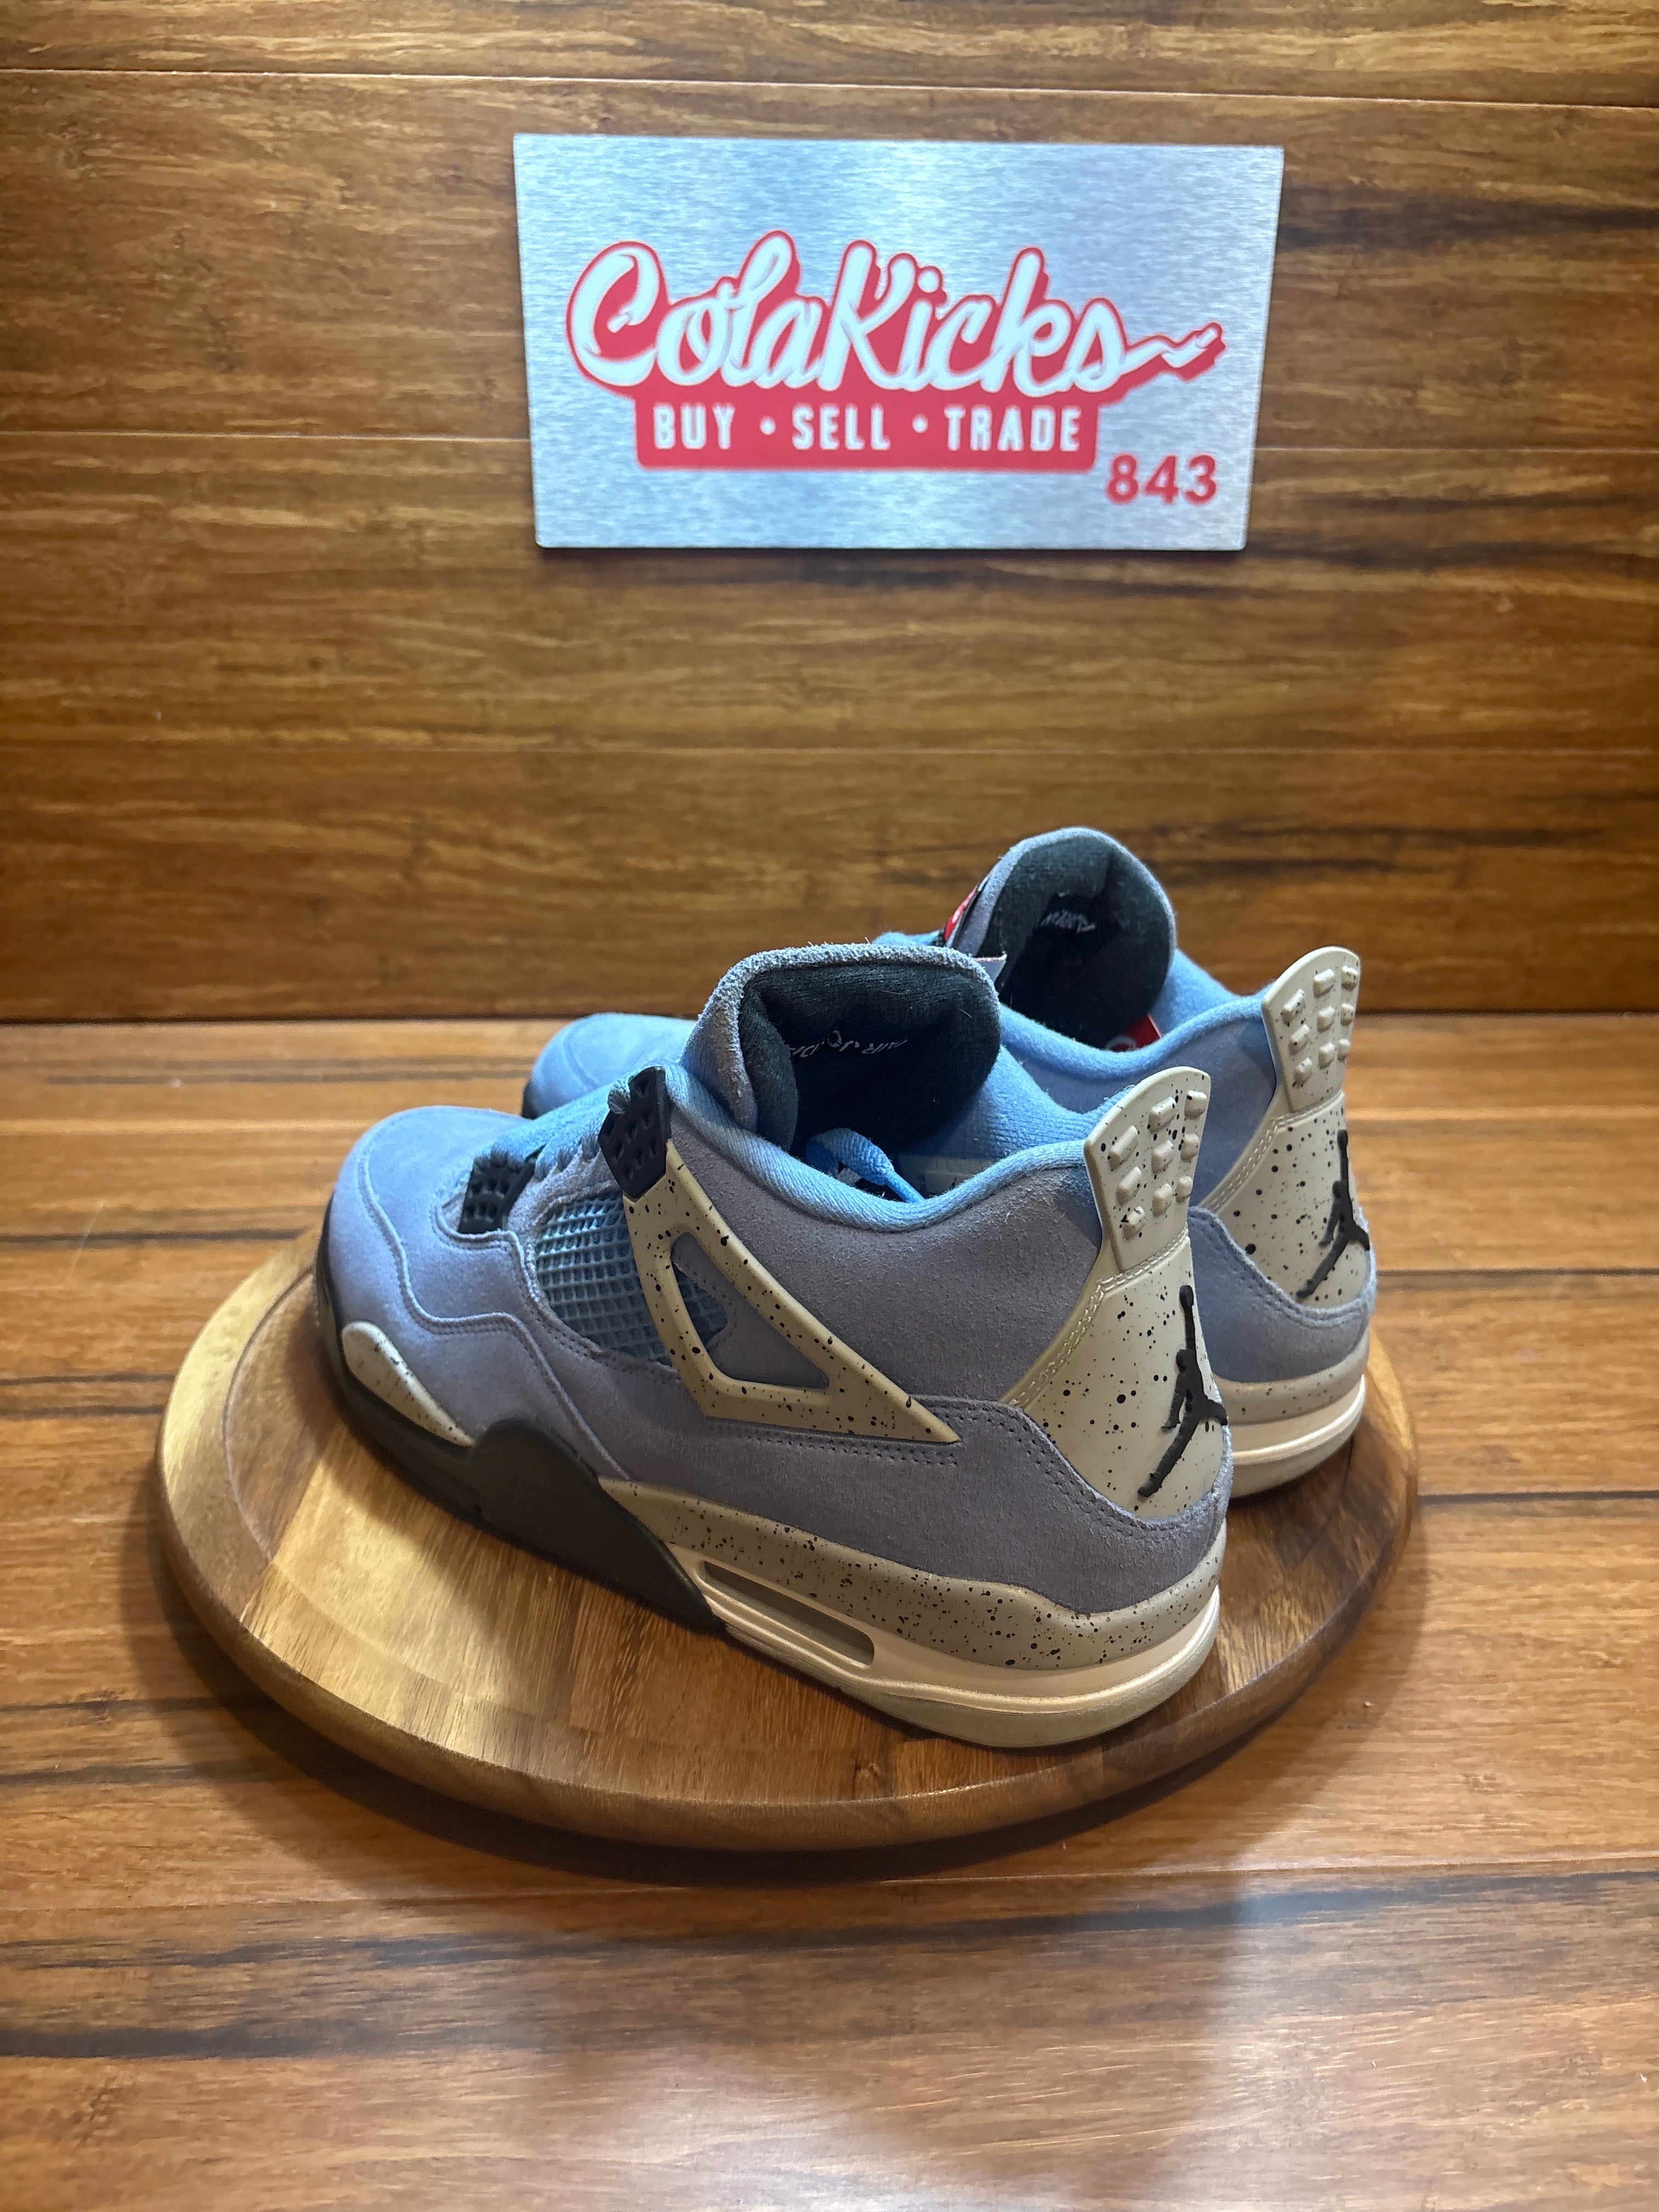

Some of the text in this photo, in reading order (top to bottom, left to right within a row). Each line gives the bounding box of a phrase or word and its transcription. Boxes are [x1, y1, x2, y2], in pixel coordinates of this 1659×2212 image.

[566, 230, 1224, 400] ColaKicks
[653, 402, 1083, 452] BUY SELL TRADE
[1105, 453, 1217, 506] 843
